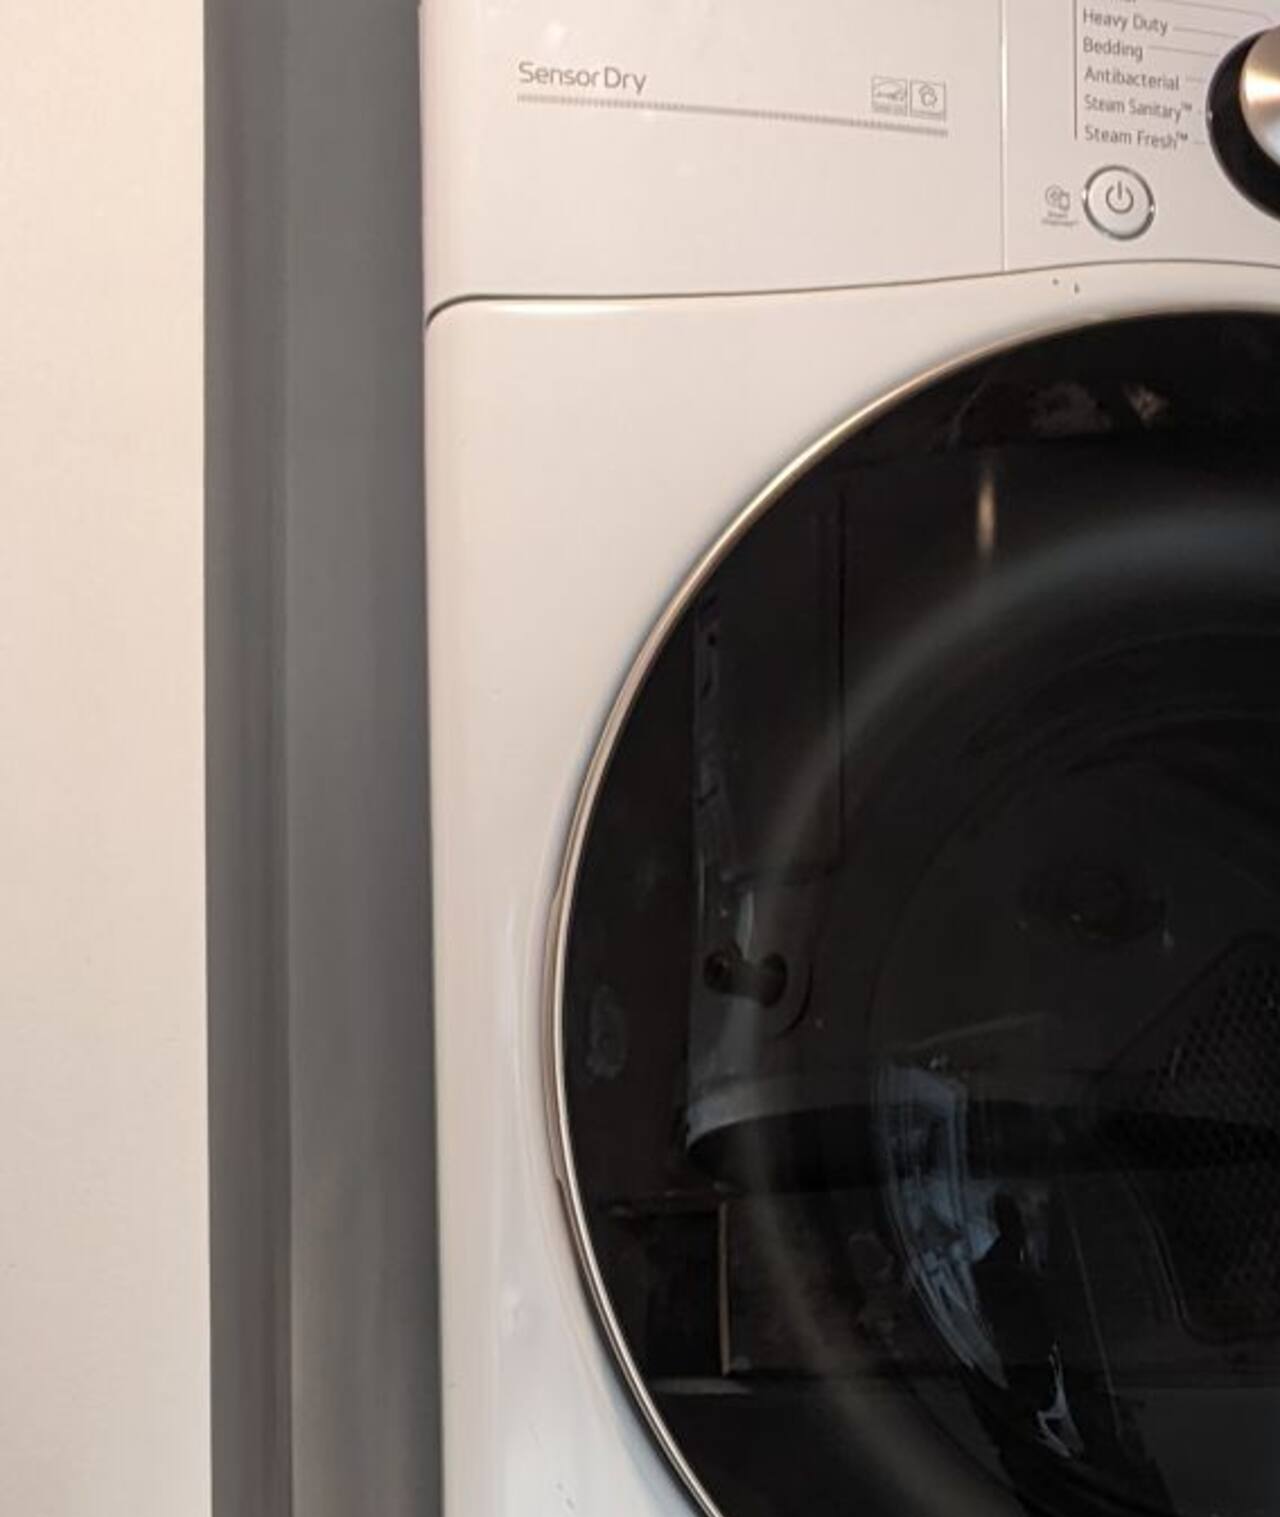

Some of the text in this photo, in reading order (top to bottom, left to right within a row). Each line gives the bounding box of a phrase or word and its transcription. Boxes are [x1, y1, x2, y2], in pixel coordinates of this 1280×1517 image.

[1082, 8, 1168, 37] Heavy Duty
[1082, 37, 1143, 62] Bedding
[1084, 66, 1180, 91] Antibacterial
[1084, 94, 1125, 114] Steam
[1084, 125, 1132, 146] Steam
